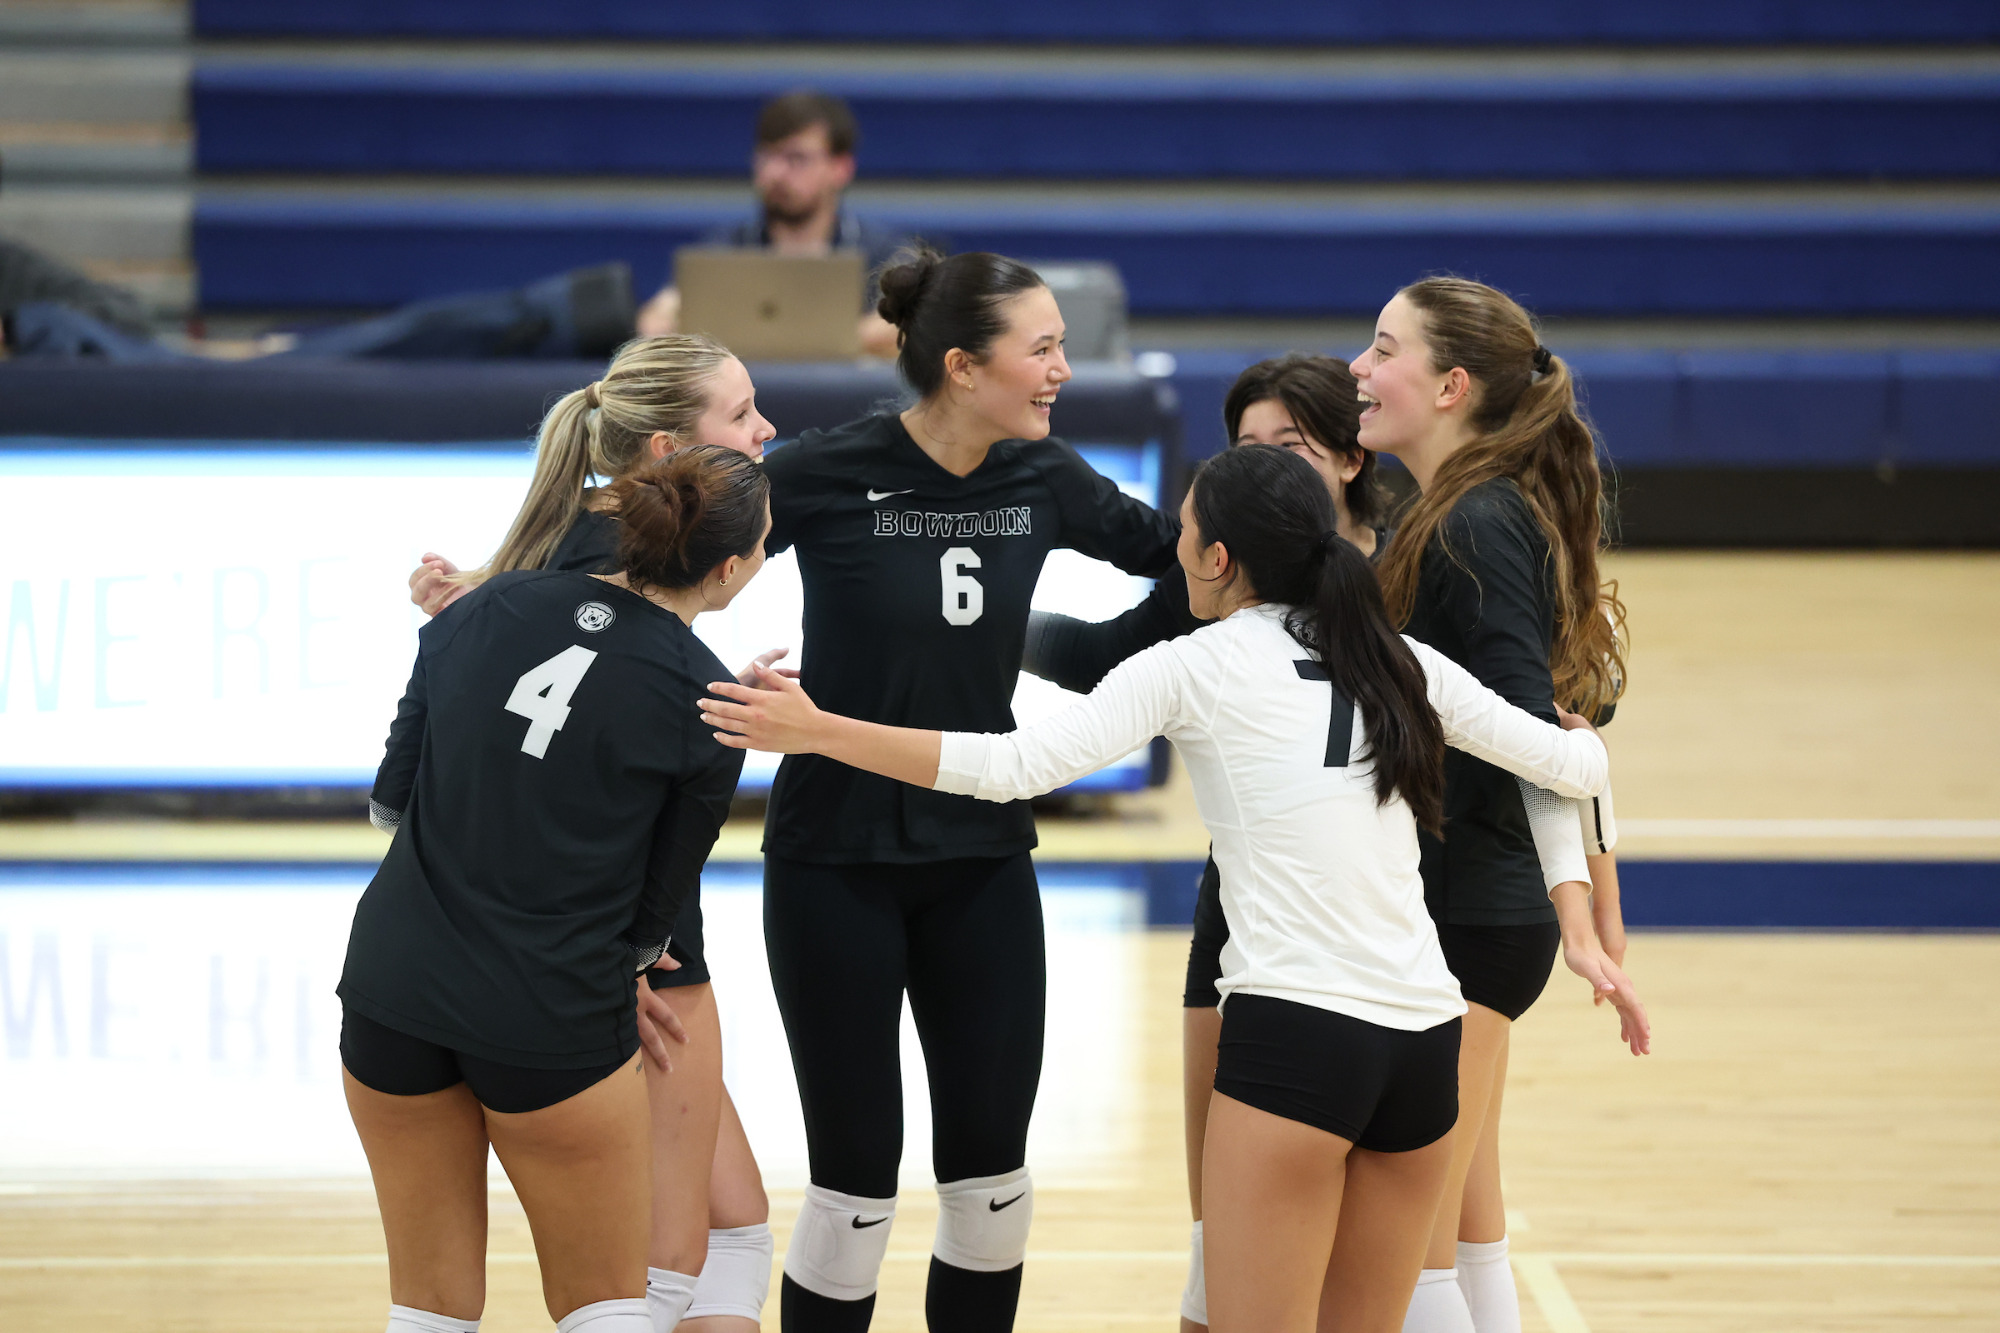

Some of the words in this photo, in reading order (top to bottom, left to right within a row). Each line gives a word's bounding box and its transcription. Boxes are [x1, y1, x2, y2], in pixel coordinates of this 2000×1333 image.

[874, 507, 1032, 538] BOWDOIN
[939, 547, 984, 626] 6
[503, 644, 599, 760] 4
[1291, 659, 1356, 768] 7
